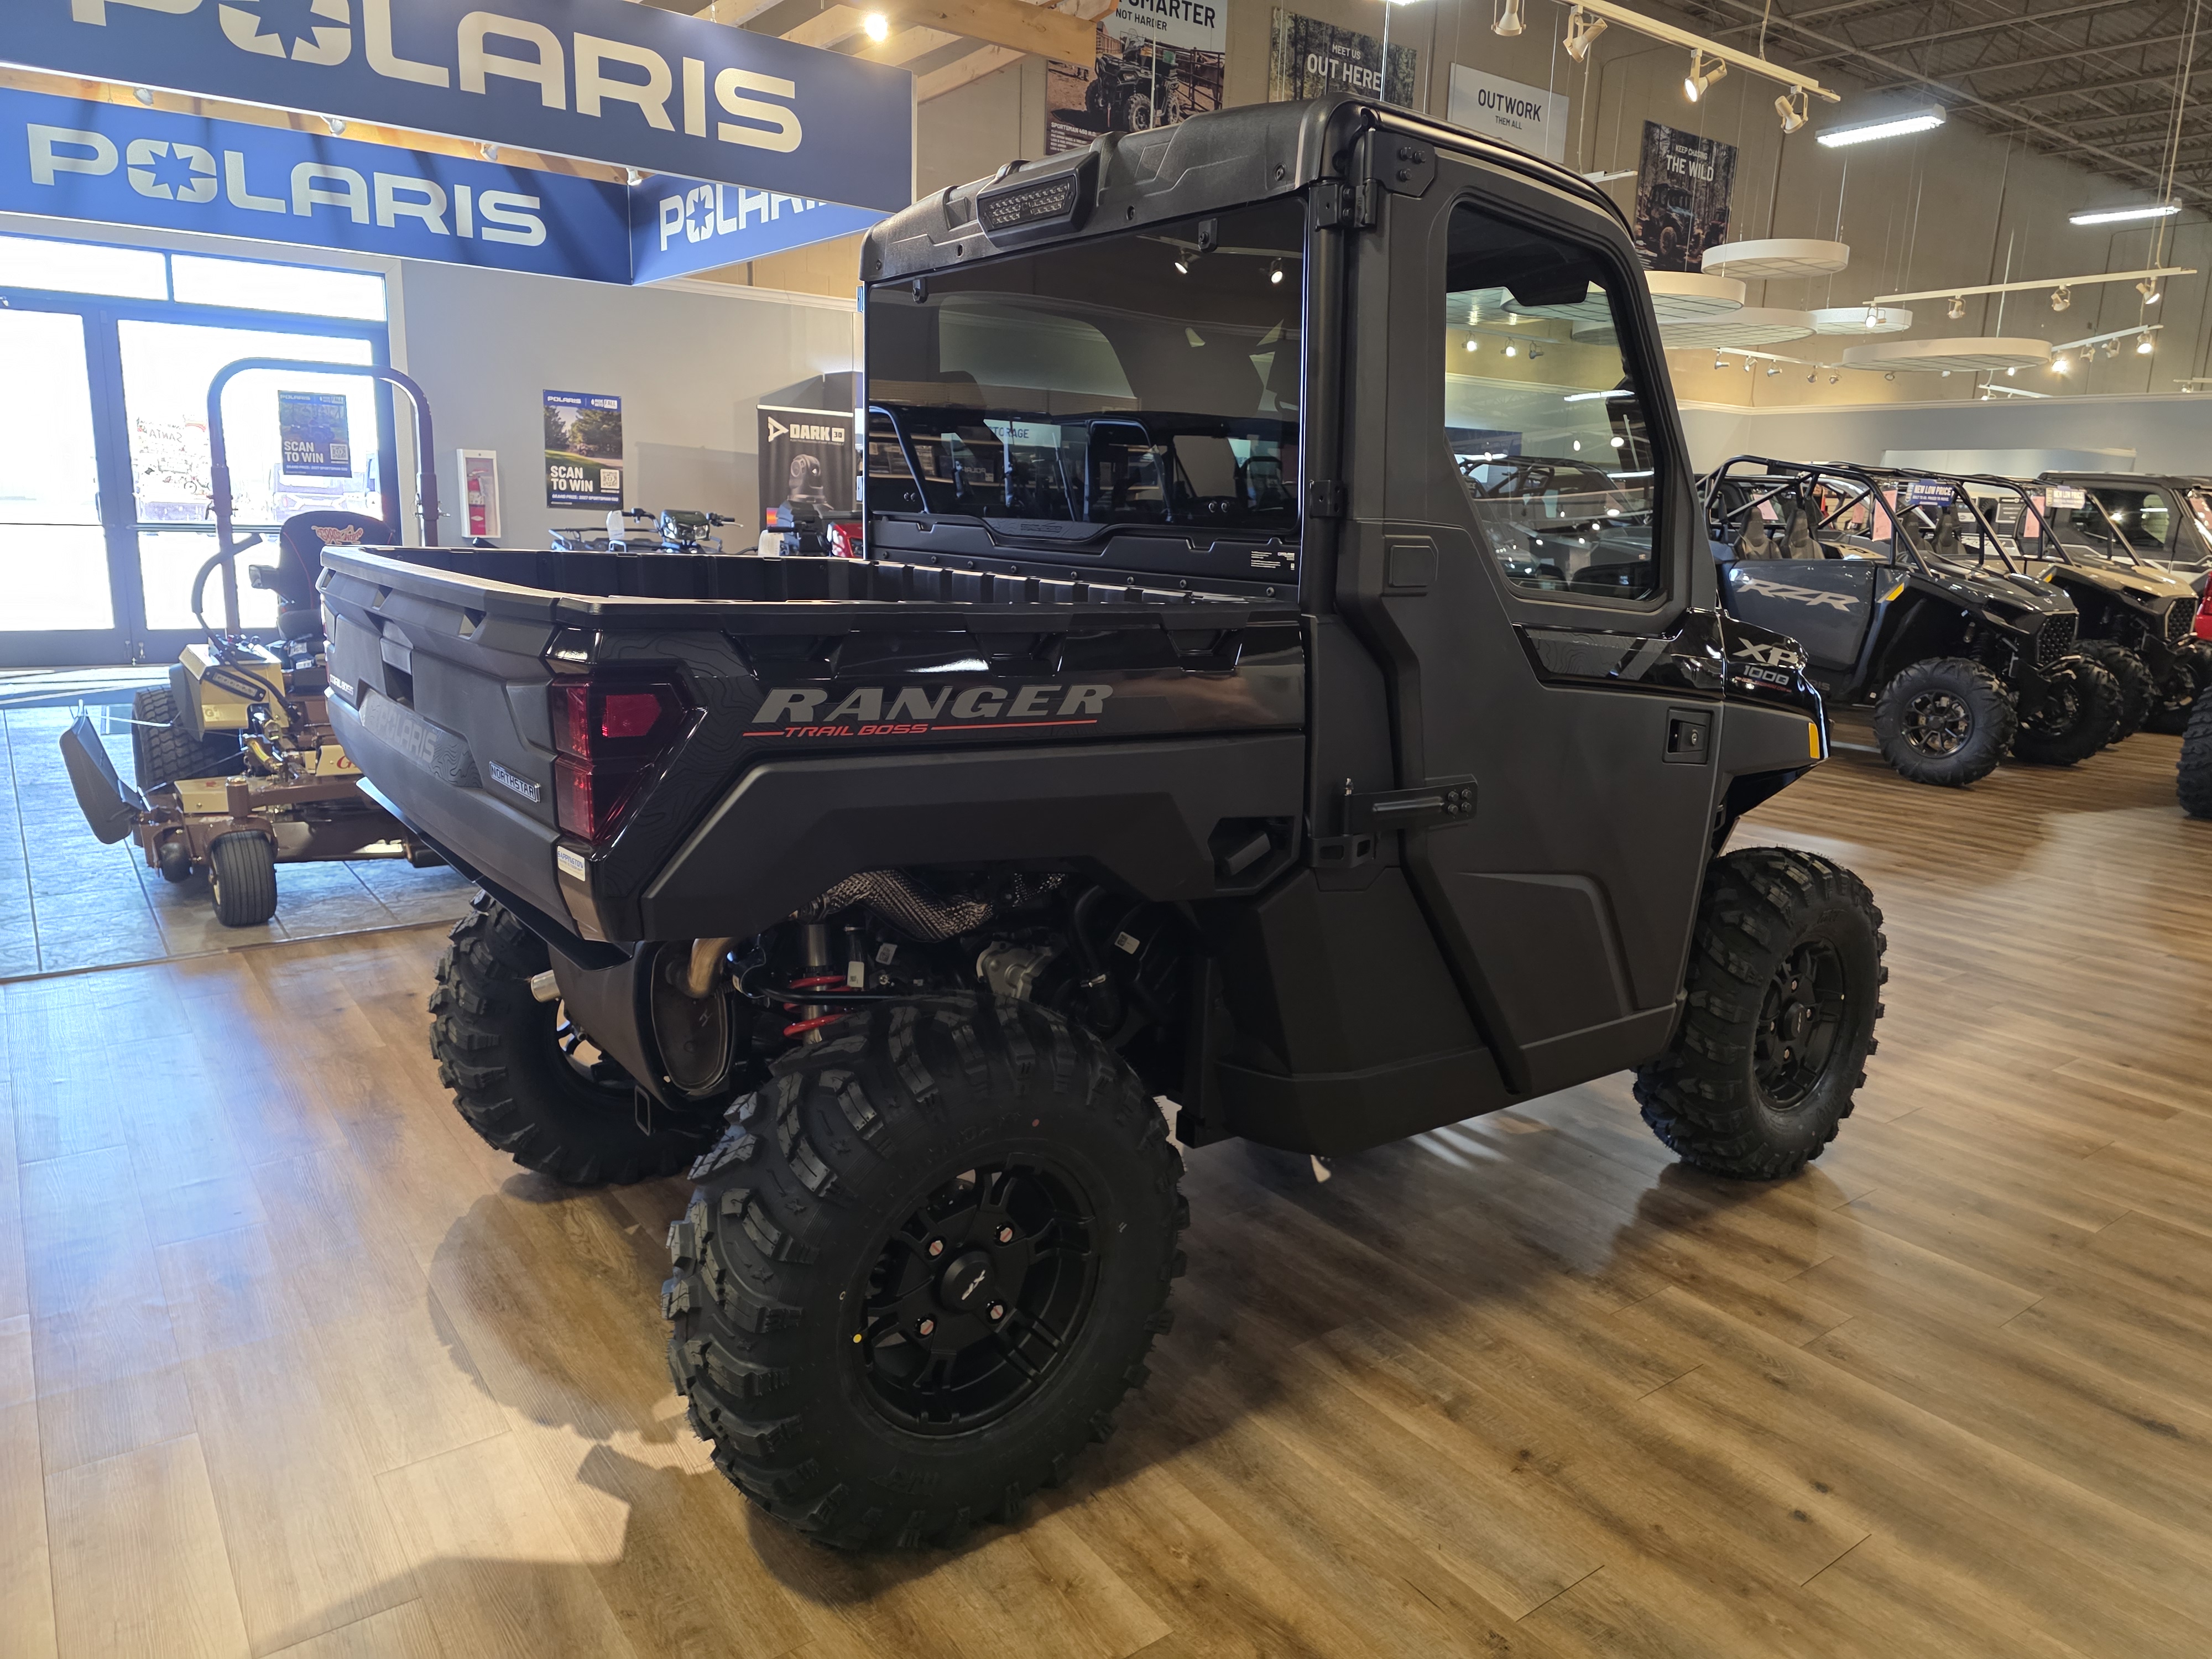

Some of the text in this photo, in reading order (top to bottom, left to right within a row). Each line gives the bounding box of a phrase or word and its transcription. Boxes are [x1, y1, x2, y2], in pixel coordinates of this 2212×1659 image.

[1115, 8, 1167, 31] NOT HARDER
[1332, 44, 1361, 60] MEET US
[1307, 54, 1381, 91] OUT HERE
[1478, 89, 1542, 122] OUTWORK
[1051, 122, 1073, 133] SPORTSMAN
[1495, 115, 1522, 130] THEM ALL
[1676, 144, 1708, 160] KEEP CHASING
[1667, 154, 1714, 181] THE WILD
[27, 123, 547, 247] POLARIS
[790, 424, 830, 441] DARK
[284, 441, 314, 452] SCAN
[284, 451, 324, 463] TO WIN
[550, 466, 583, 479] SCAN
[550, 478, 593, 492] TO WIN
[1914, 485, 1952, 495] NEW LOW PRICE
[1736, 578, 1860, 612] RZR
[1732, 637, 1798, 666] XP
[330, 674, 354, 696] TRAIL BOSS
[1743, 665, 1790, 685] 1000
[752, 684, 1113, 723] RANGER
[378, 705, 437, 764] POLARIS
[784, 724, 929, 737] TRAIL BOSS
[491, 765, 535, 799] NORTHSTAR
[962, 1269, 986, 1300] XP
